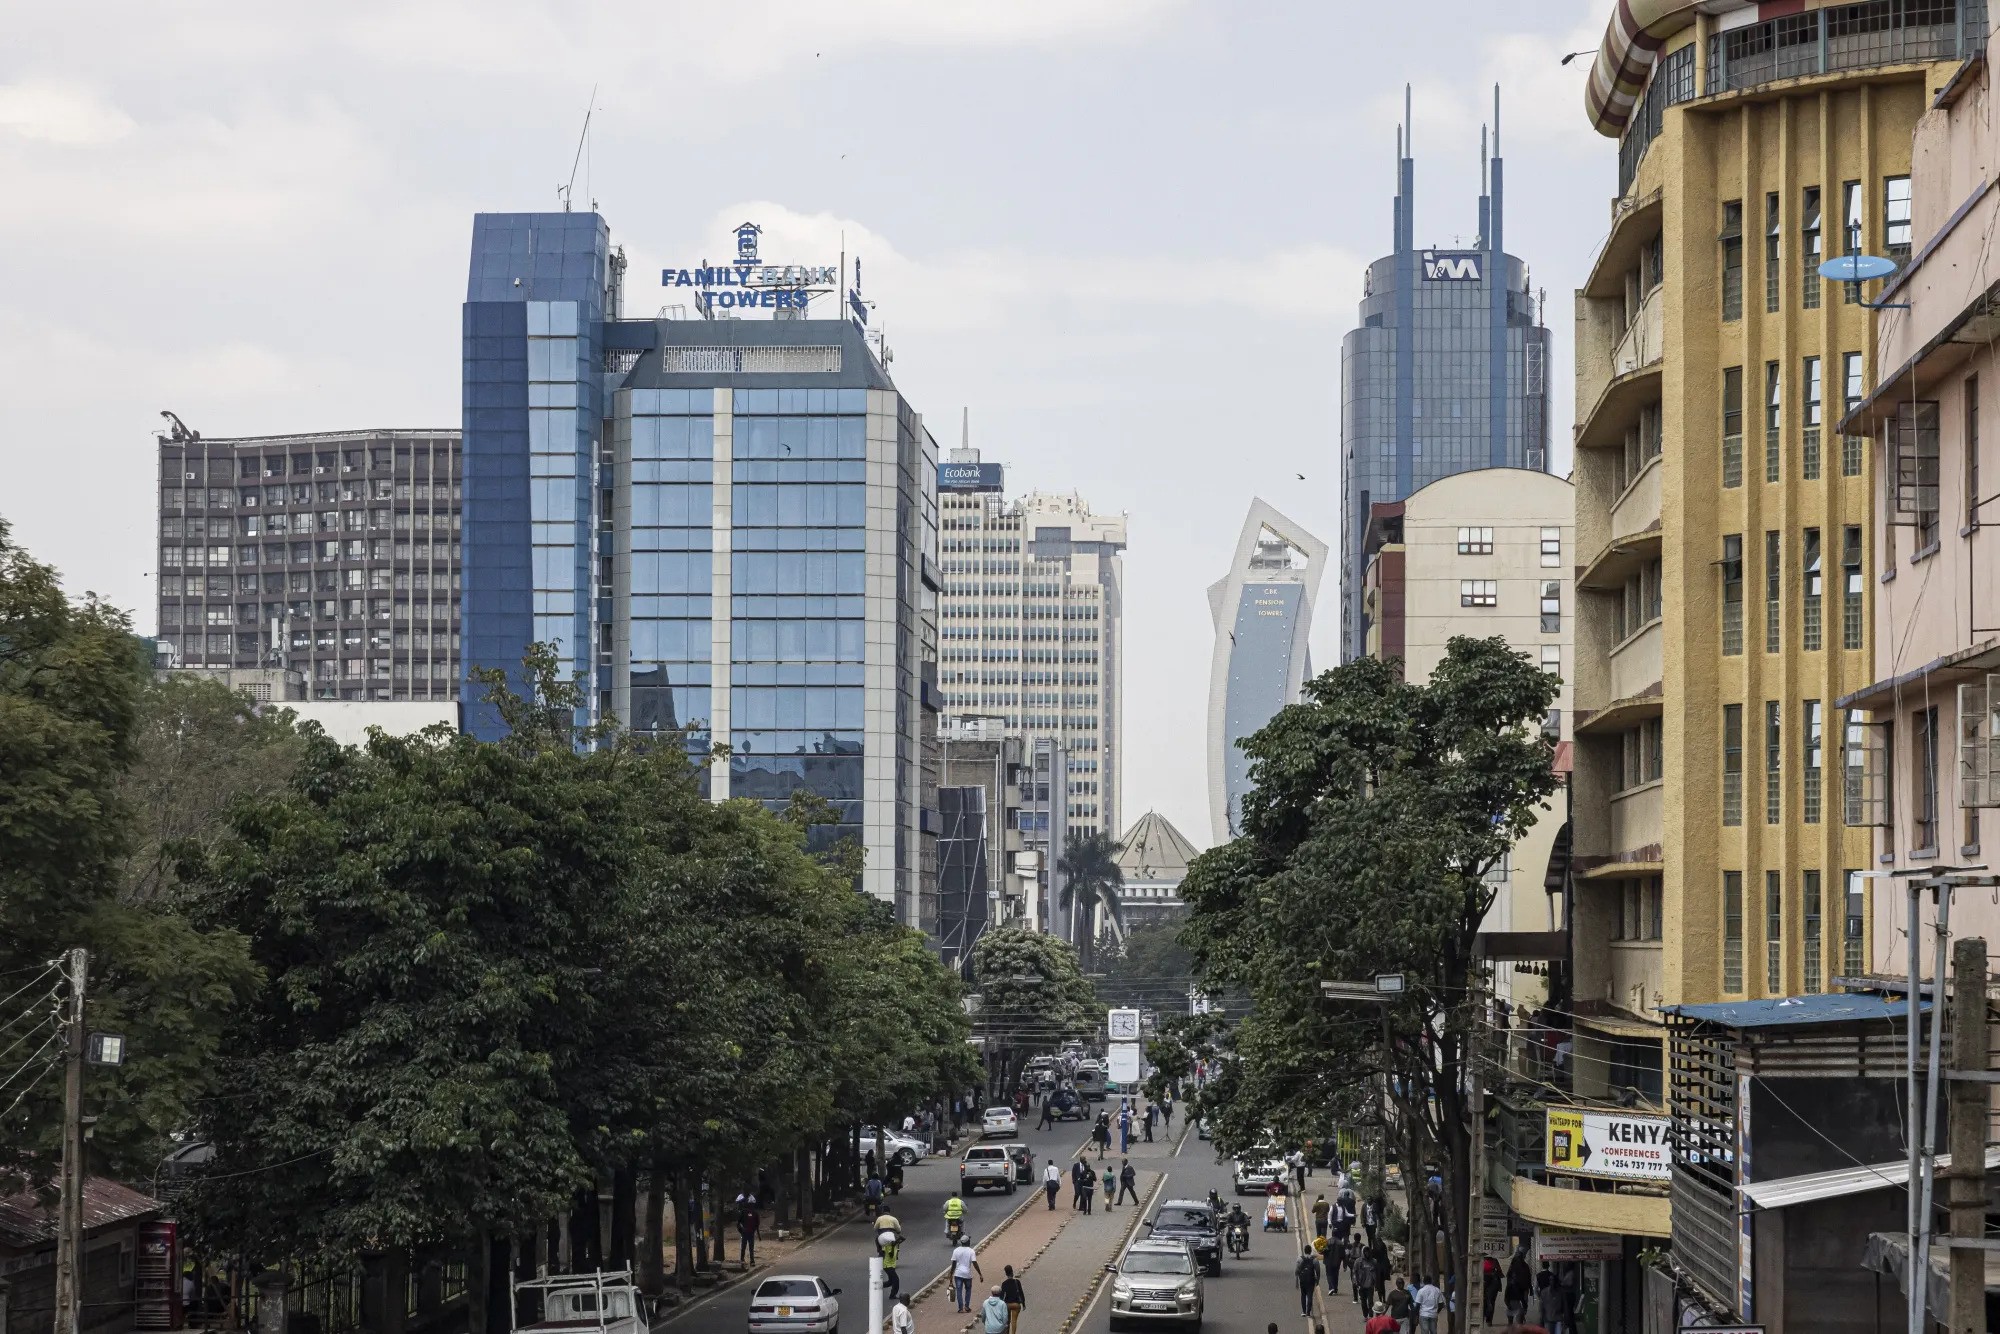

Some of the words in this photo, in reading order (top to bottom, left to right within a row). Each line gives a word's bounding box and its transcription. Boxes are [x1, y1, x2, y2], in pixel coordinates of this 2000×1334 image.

[662, 267, 752, 287] FAMILY
[762, 266, 837, 285] BANK
[702, 290, 809, 309] TOWERS
[945, 466, 981, 478] Ecobank
[1571, 1119, 1582, 1128] FOR
[1609, 1122, 1671, 1145] KENYA
[1612, 1160, 1629, 1168] +254
[1631, 1161, 1645, 1170] 737
[1648, 1162, 1662, 1171] 777
